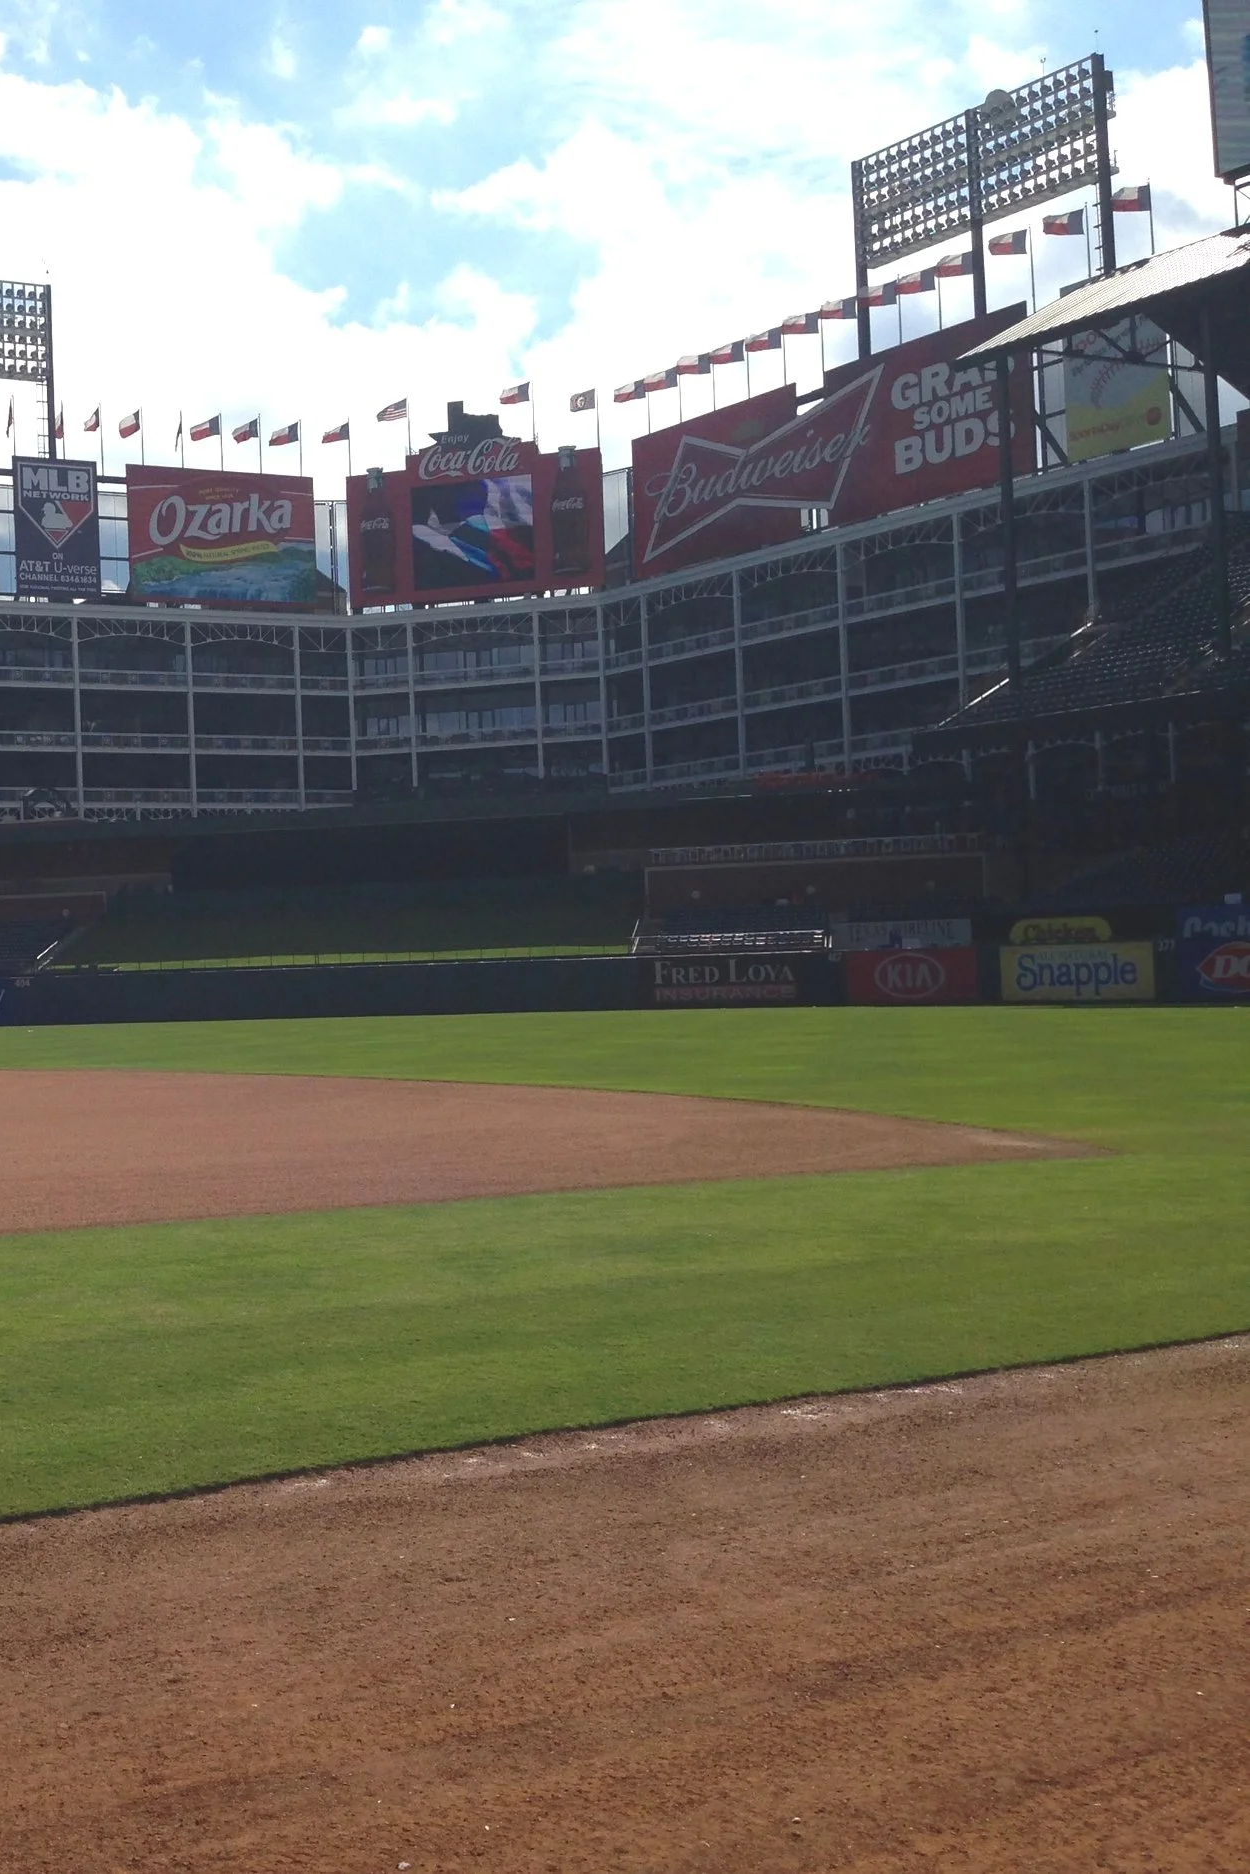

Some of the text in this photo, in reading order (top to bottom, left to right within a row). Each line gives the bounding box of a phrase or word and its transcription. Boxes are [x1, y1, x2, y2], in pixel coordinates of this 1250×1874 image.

[913, 386, 993, 431] SOME
[441, 434, 470, 445] Enjoy
[22, 466, 89, 493] MLB
[645, 424, 872, 518] Budweiser
[23, 490, 89, 501] NETWORK
[149, 494, 292, 546] Ozarka
[52, 552, 63, 560] ON
[19, 560, 97, 575] AT&T U-verse
[19, 573, 58, 582] CHANNEL
[887, 963, 933, 989] KIA
[1016, 952, 1138, 996] Snapple
[654, 985, 796, 1001] INSURANCE
